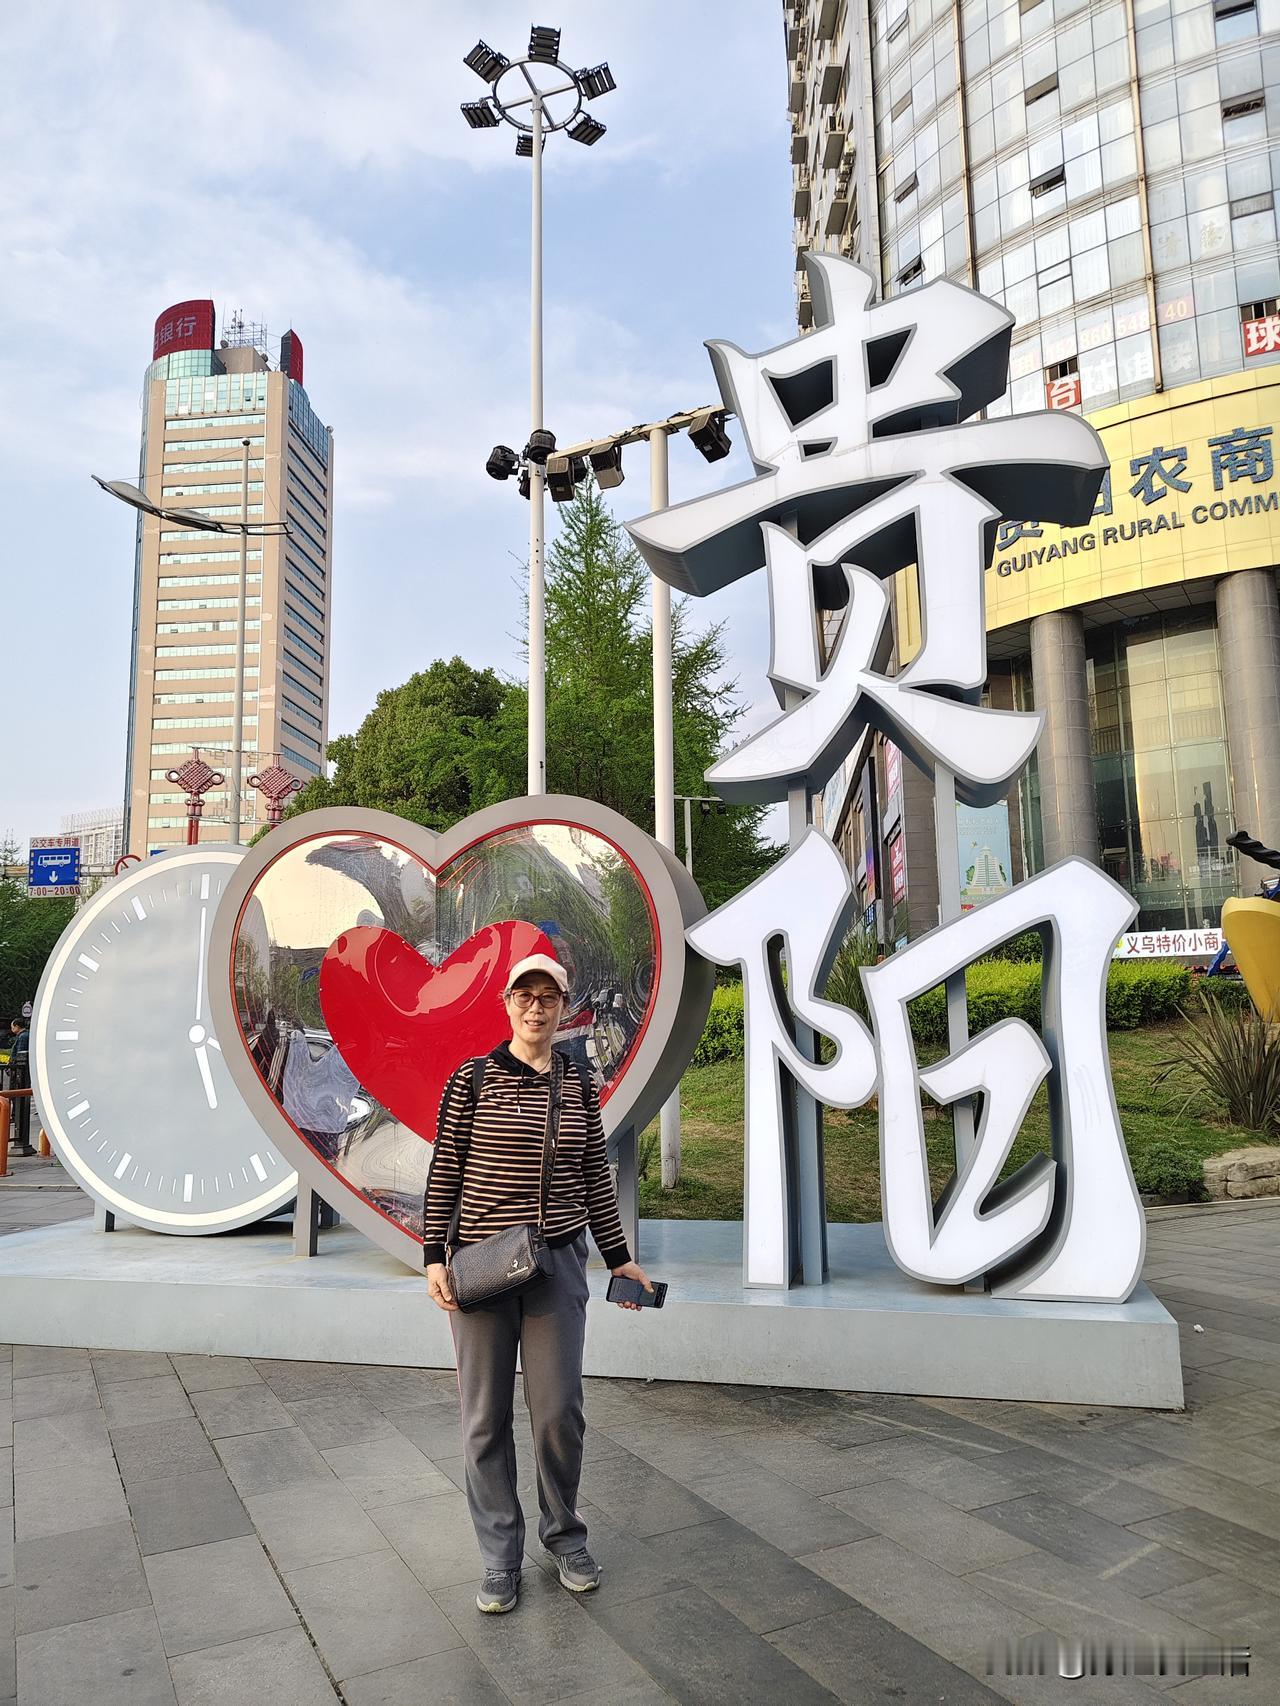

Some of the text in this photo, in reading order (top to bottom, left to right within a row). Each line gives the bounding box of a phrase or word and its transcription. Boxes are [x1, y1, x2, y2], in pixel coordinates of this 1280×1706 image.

[996, 491, 1280, 577] GUIYANG RURAL COMM
[626, 252, 1147, 1304] 贵阳
[32, 838, 79, 848] 公交车专用道
[1126, 931, 1224, 955] 义乌特价小商
